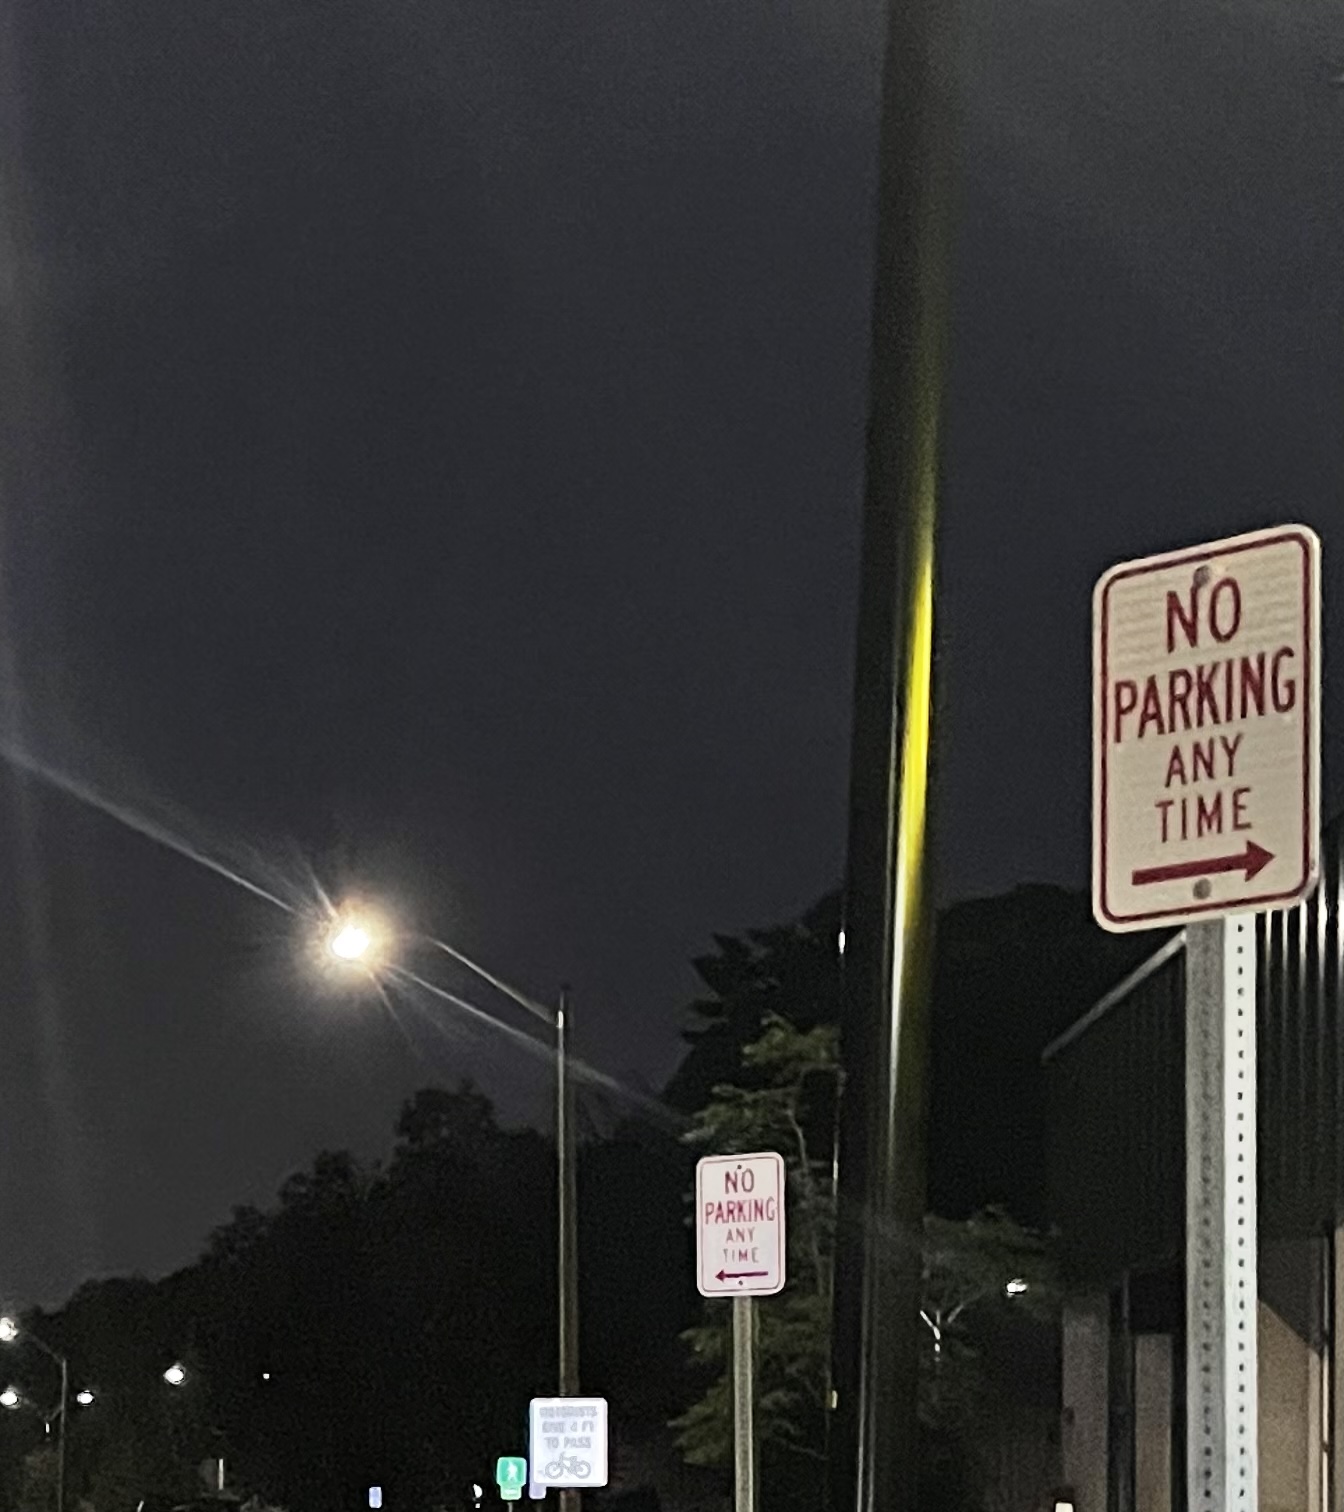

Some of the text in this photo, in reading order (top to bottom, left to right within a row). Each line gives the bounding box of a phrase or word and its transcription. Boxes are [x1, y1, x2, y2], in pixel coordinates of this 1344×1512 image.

[1166, 577, 1242, 653] NO
[1113, 646, 1297, 743] PARKING
[1164, 732, 1244, 788] ANY
[1154, 787, 1253, 843] TIME
[724, 1167, 755, 1195] NO
[704, 1196, 776, 1225] PARKING
[723, 1247, 760, 1263] TIME
[725, 1226, 756, 1243] ANY
